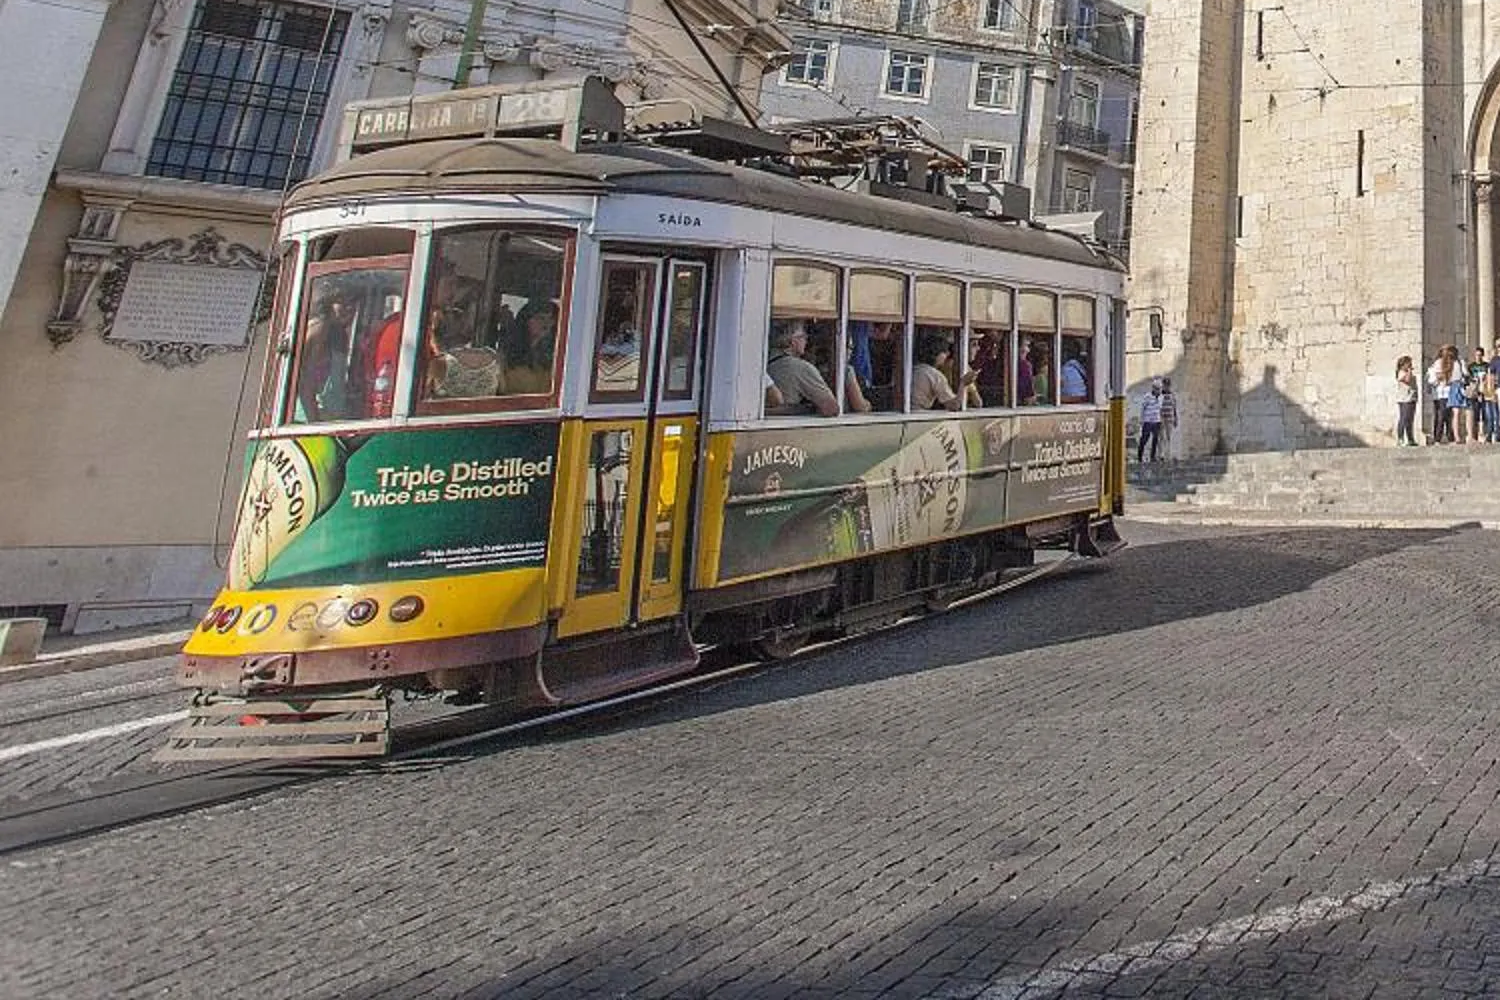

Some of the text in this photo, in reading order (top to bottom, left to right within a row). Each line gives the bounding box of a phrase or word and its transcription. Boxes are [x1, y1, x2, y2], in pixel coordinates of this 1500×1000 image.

[658, 211, 701, 226] SAÍDA
[743, 446, 807, 475] JAMESON
[377, 455, 553, 491] Triple Distilled
[351, 489, 411, 508] Twice
[413, 490, 441, 504] as
